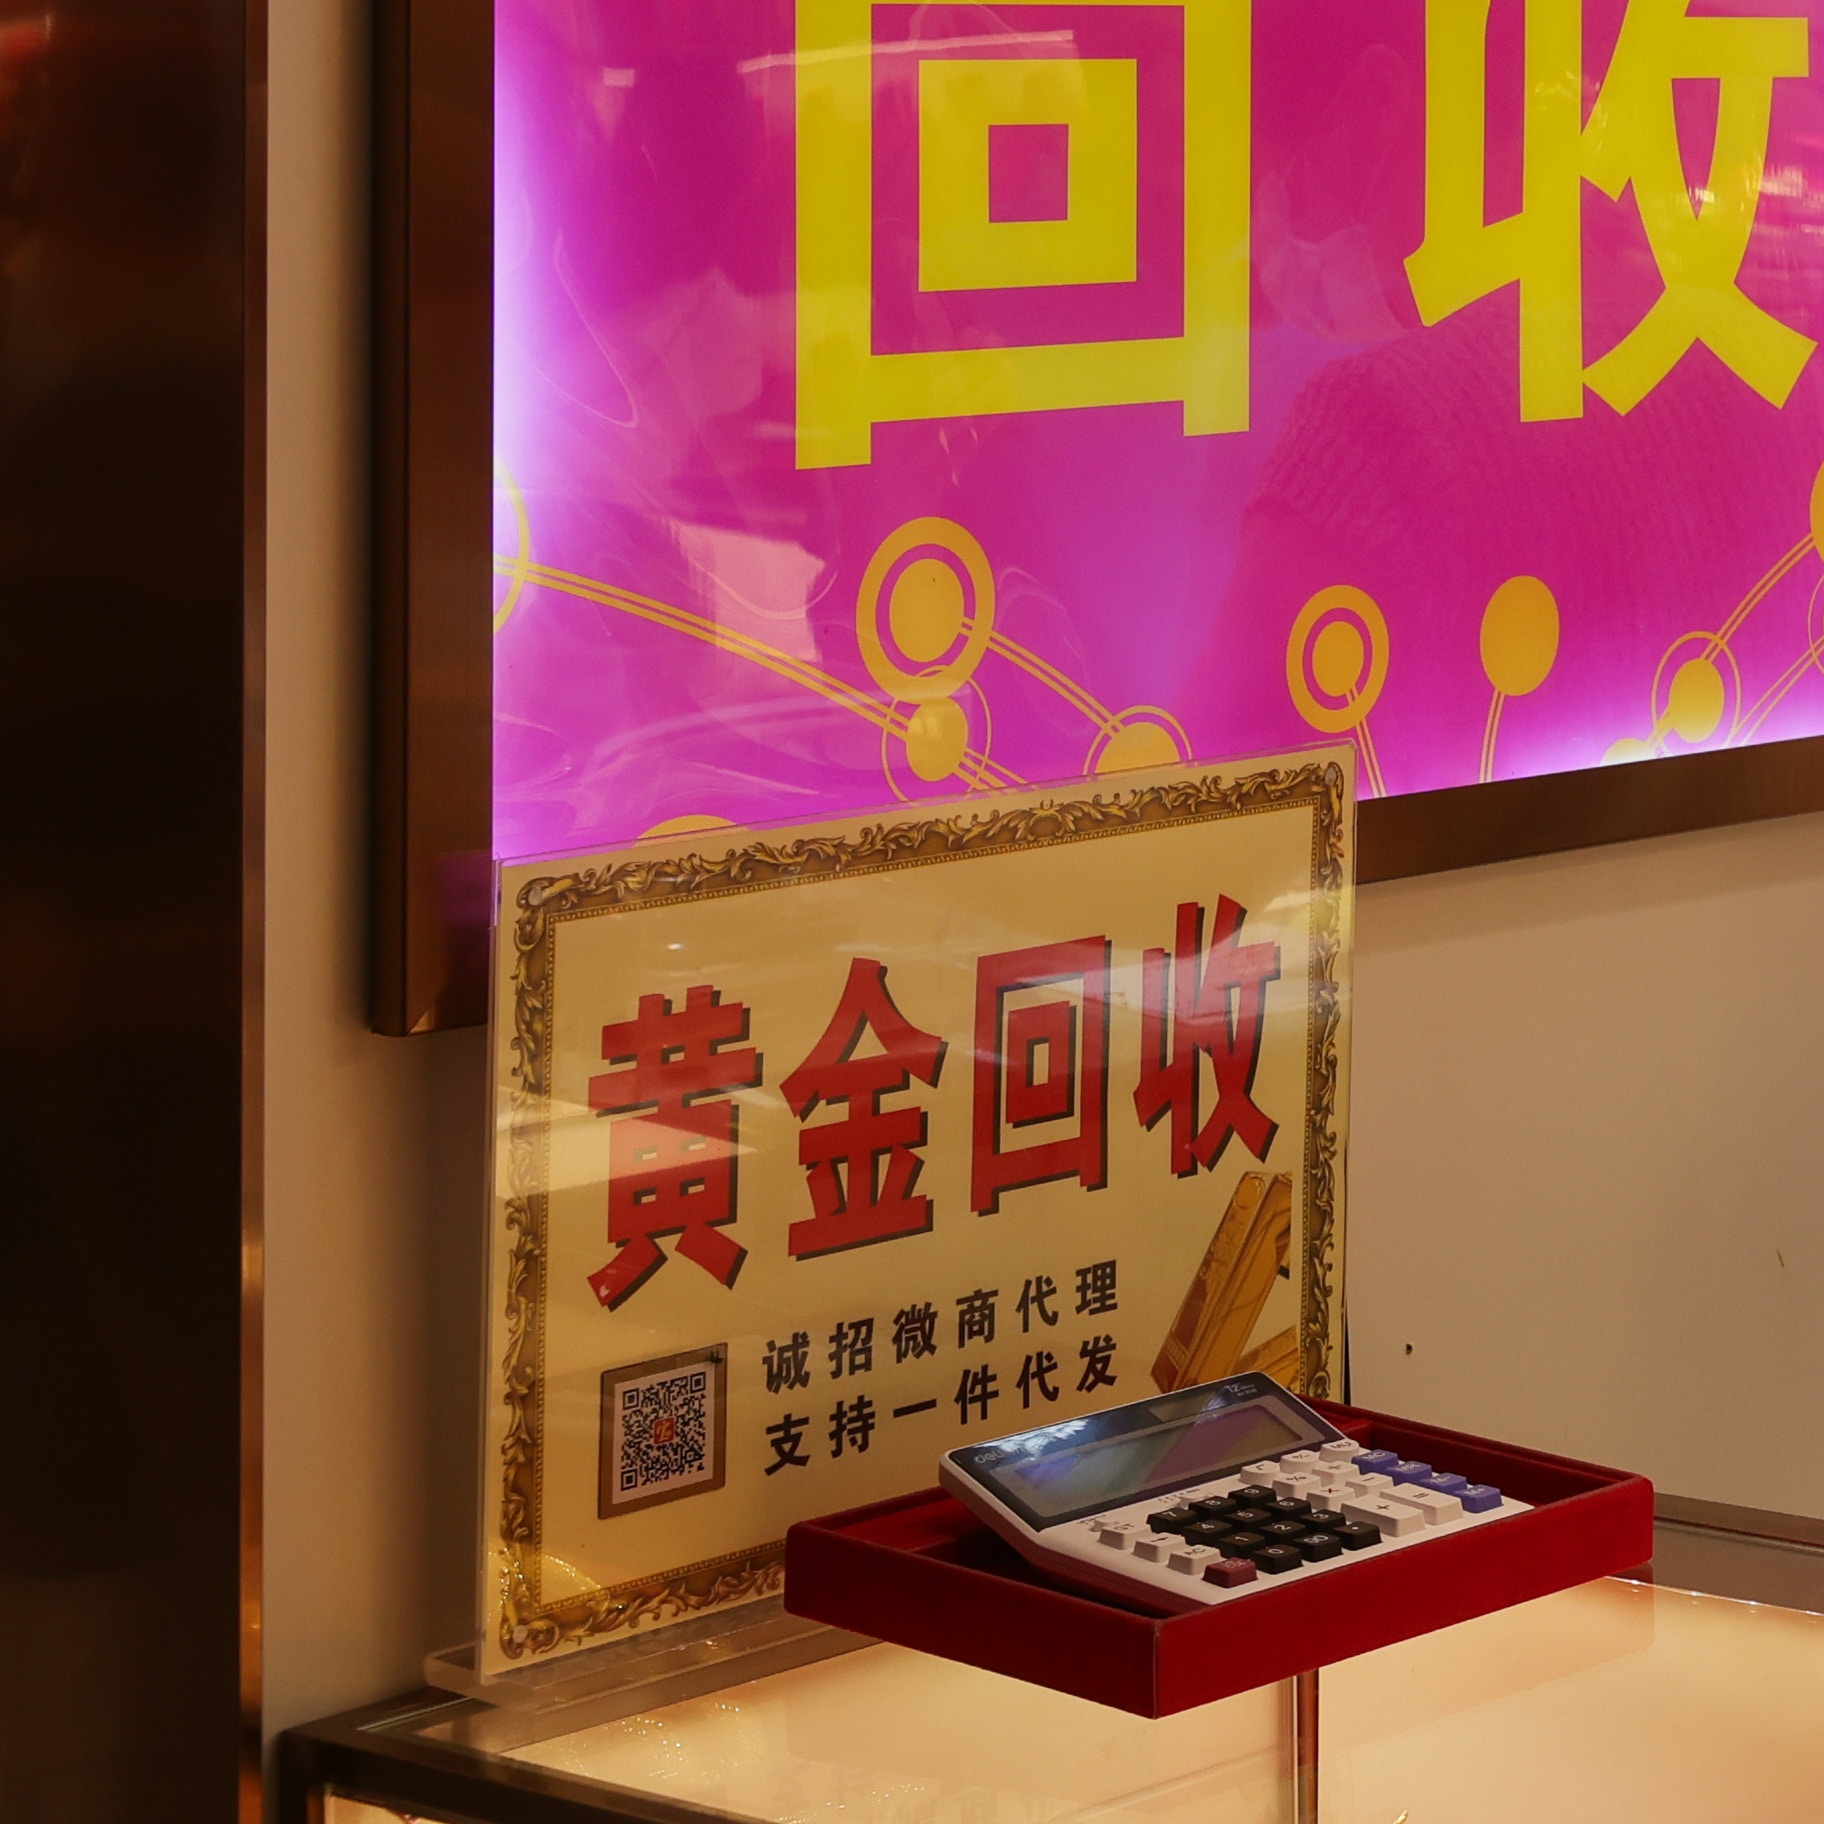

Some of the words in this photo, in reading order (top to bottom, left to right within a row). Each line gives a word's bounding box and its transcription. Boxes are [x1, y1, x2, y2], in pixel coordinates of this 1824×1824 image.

[587, 894, 1280, 1312] 黄金回收
[762, 1259, 1118, 1395] 诚招微商代理
[764, 1334, 1118, 1476] 支持一件代发
